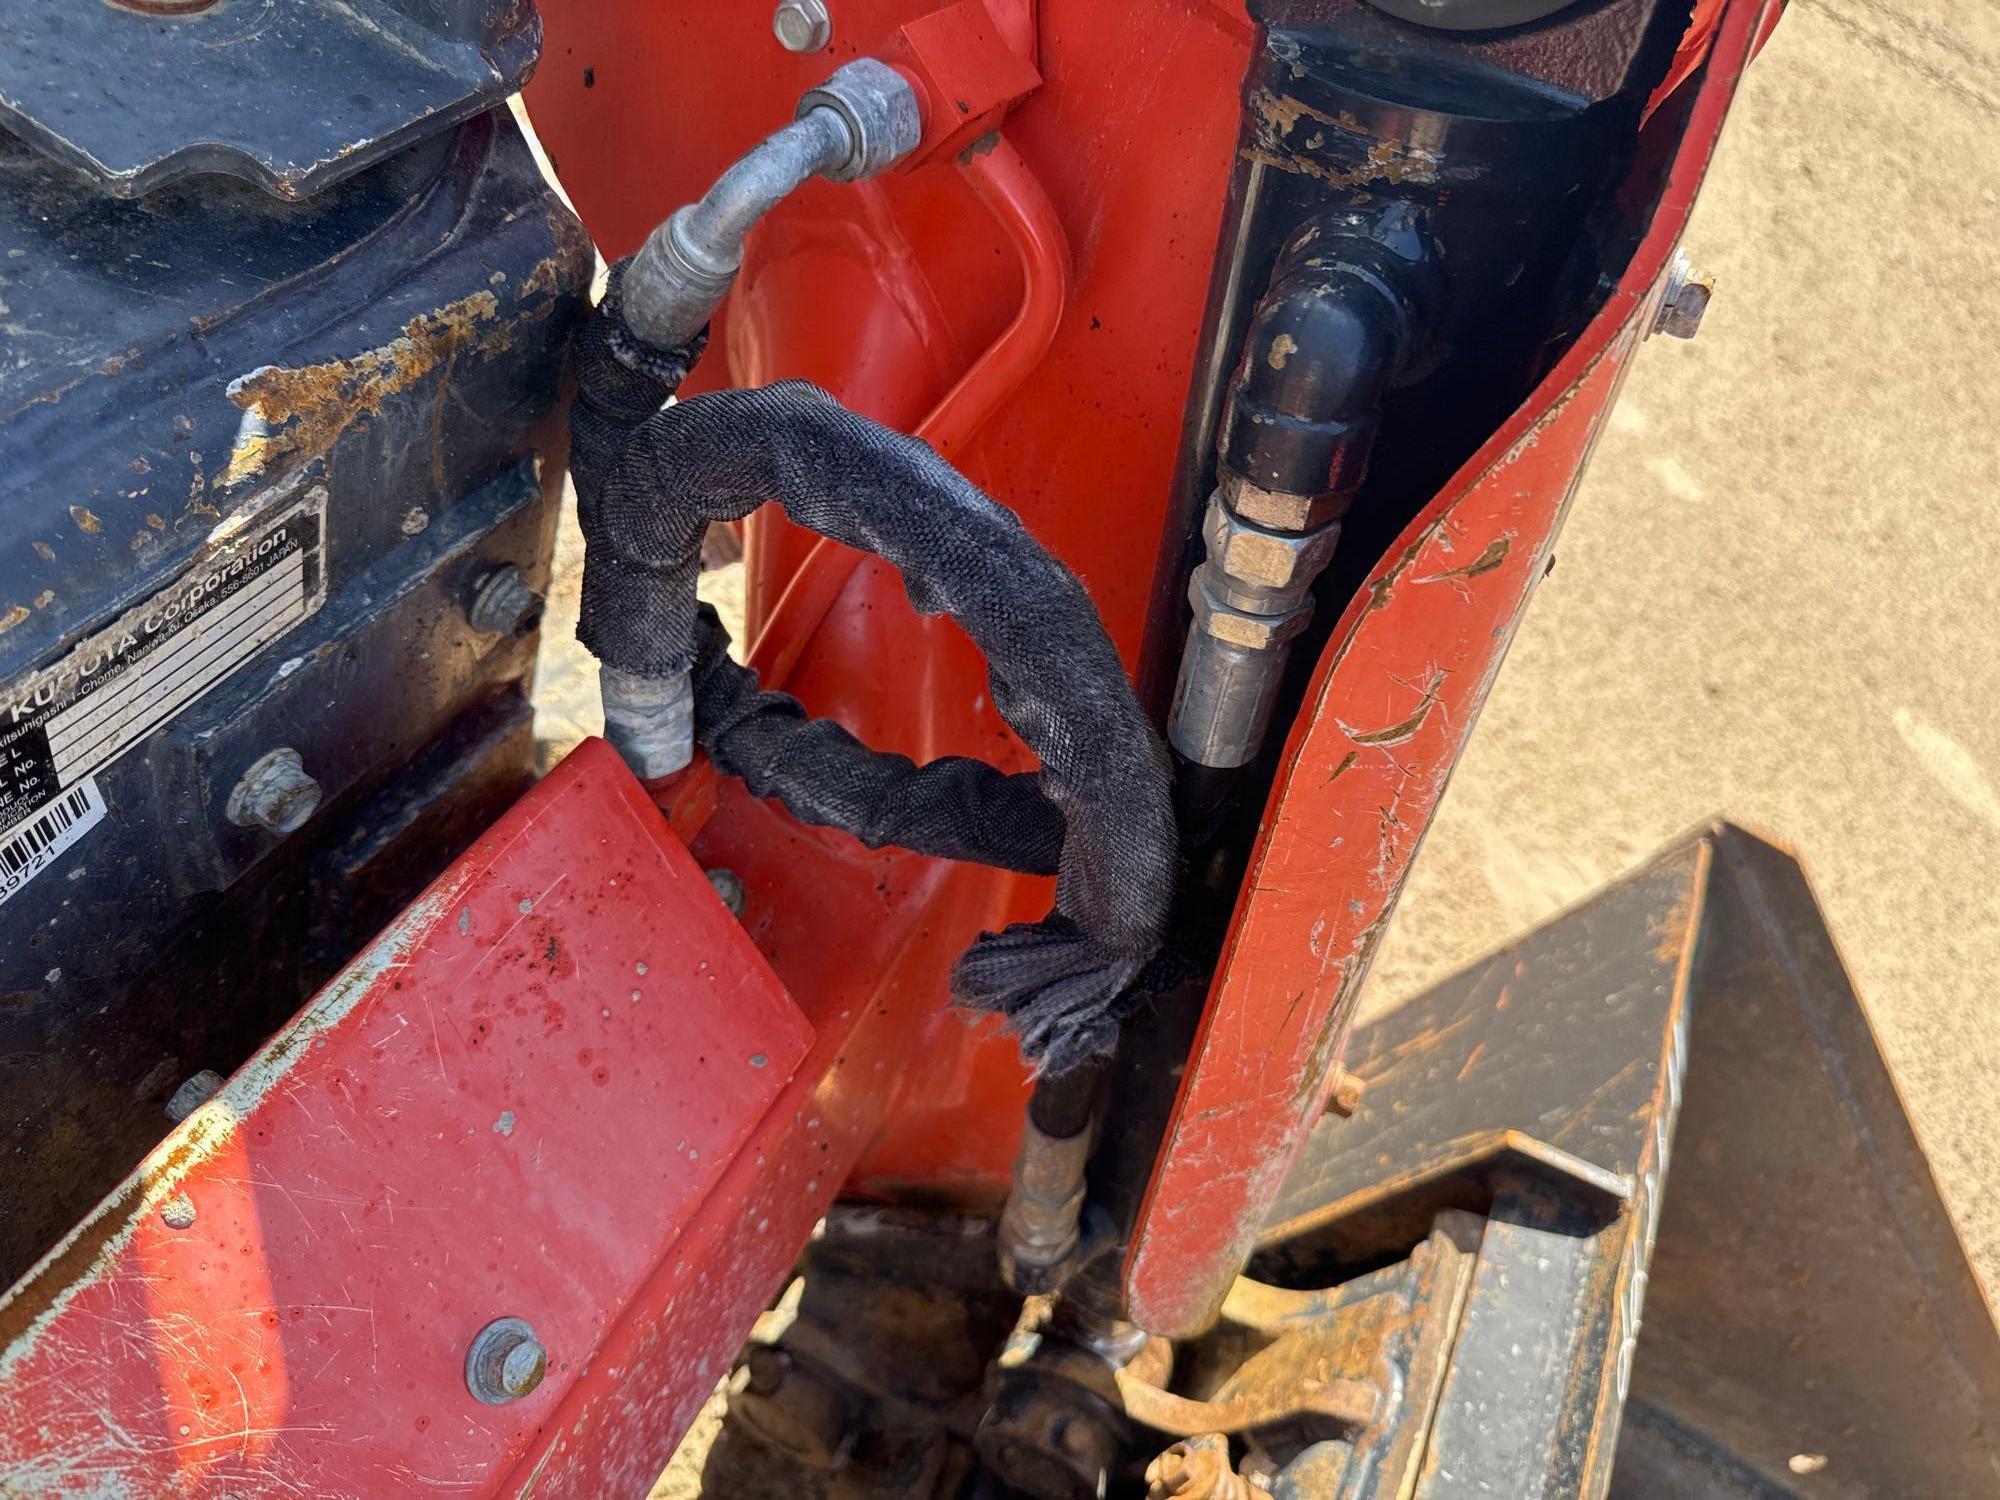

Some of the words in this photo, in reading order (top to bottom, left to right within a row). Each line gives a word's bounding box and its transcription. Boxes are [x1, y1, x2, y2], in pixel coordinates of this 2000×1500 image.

[266, 537, 299, 567] JAPAN
[145, 527, 287, 635] Corporation
[14, 759, 37, 777] No.
[19, 776, 40, 793] No.
